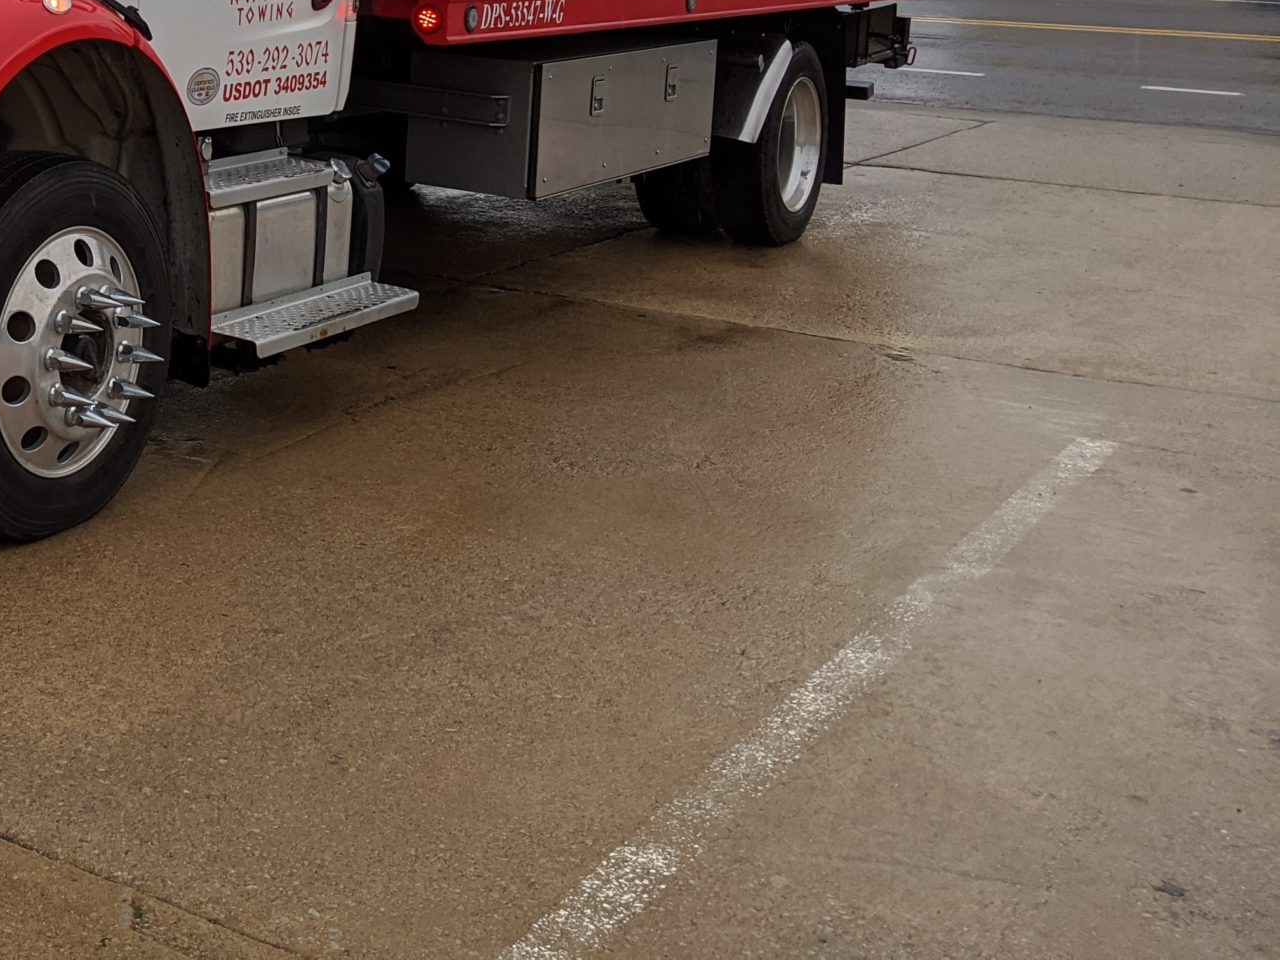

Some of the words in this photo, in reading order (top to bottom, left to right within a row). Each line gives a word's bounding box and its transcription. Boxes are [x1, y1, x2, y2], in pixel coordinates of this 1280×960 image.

[237, 1, 294, 26] TOWING
[480, 0, 565, 29] DPS-53547-W-G
[225, 40, 329, 77] 539-292-3074
[223, 79, 271, 102] USDOT
[274, 70, 327, 95] 3409354
[224, 111, 239, 124] FIRE
[239, 107, 282, 122] EXTINGUISHER
[282, 105, 302, 117] INSIDE
